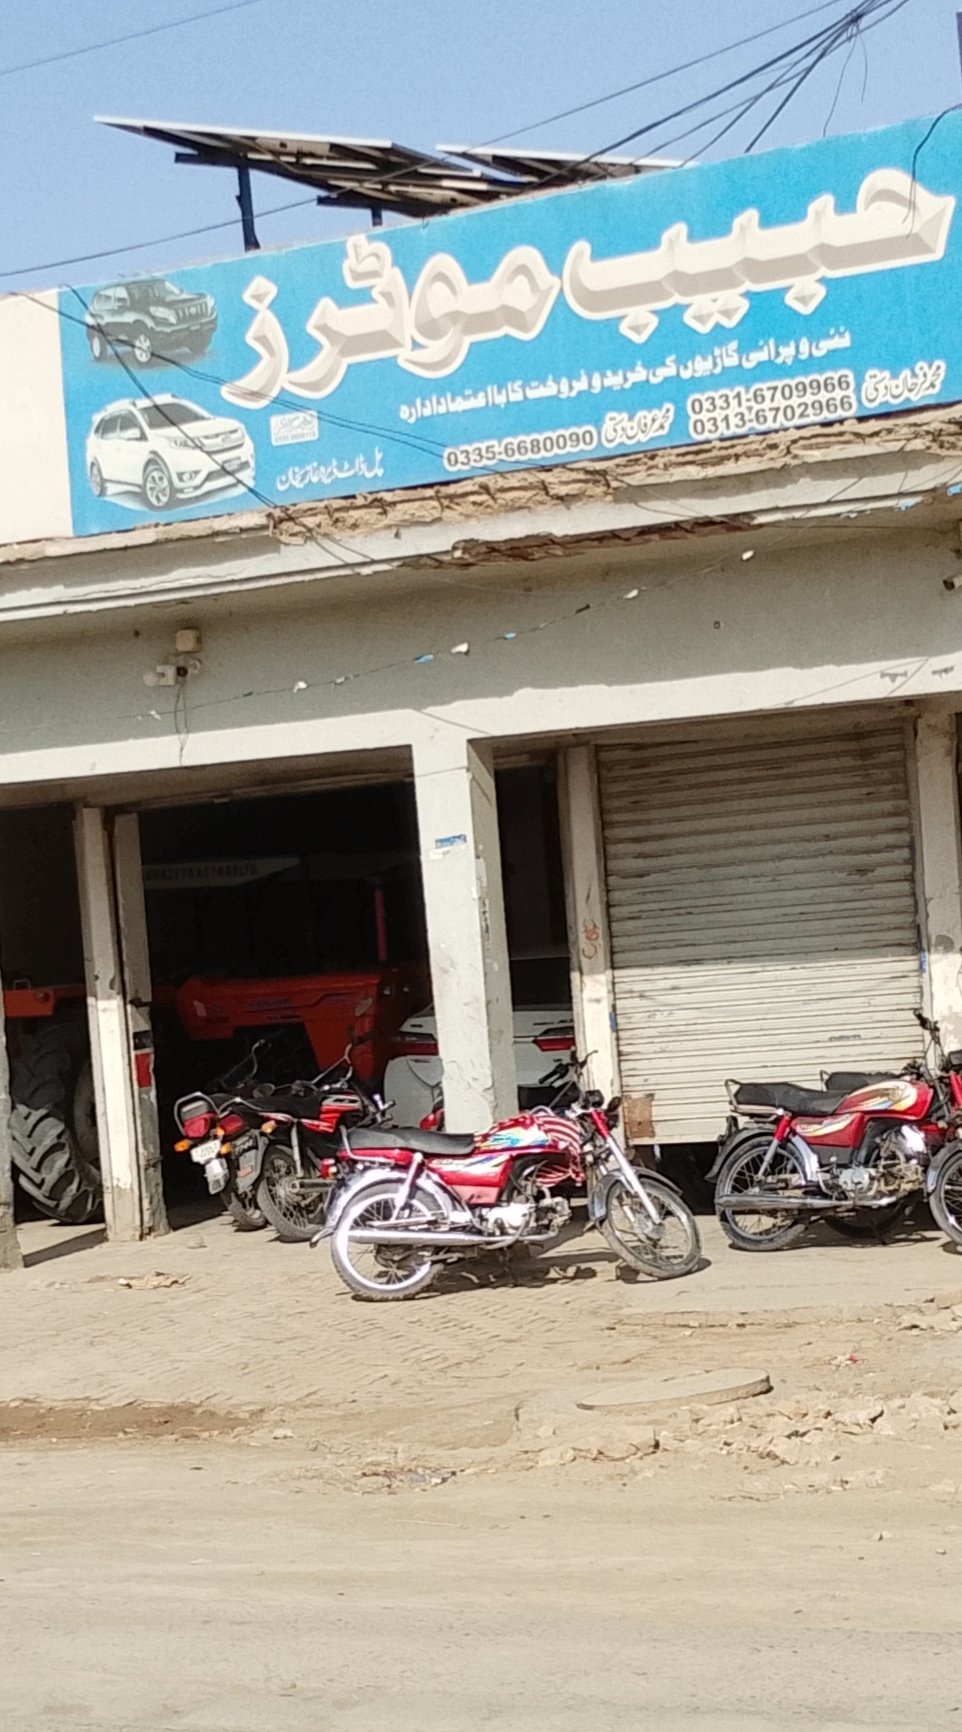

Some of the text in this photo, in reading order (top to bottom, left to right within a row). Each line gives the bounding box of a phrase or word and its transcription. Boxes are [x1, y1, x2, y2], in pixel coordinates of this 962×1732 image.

[221, 168, 956, 409] حبیب موٹرز
[649, 353, 678, 385] کی
[679, 338, 740, 380] گاڑیوں
[741, 336, 795, 370] پرانی
[507, 379, 524, 403] کا
[525, 368, 589, 400] فروخت
[590, 371, 602, 394] و
[602, 359, 648, 391] خرید
[888, 363, 928, 400] فرحان
[922, 362, 944, 393] محمد
[690, 372, 852, 416] 0331-6709966
[624, 412, 659, 441] عرفان
[652, 406, 672, 434] محمد
[692, 393, 854, 437] 0313-6702966
[445, 428, 596, 469] 0335-6680090
